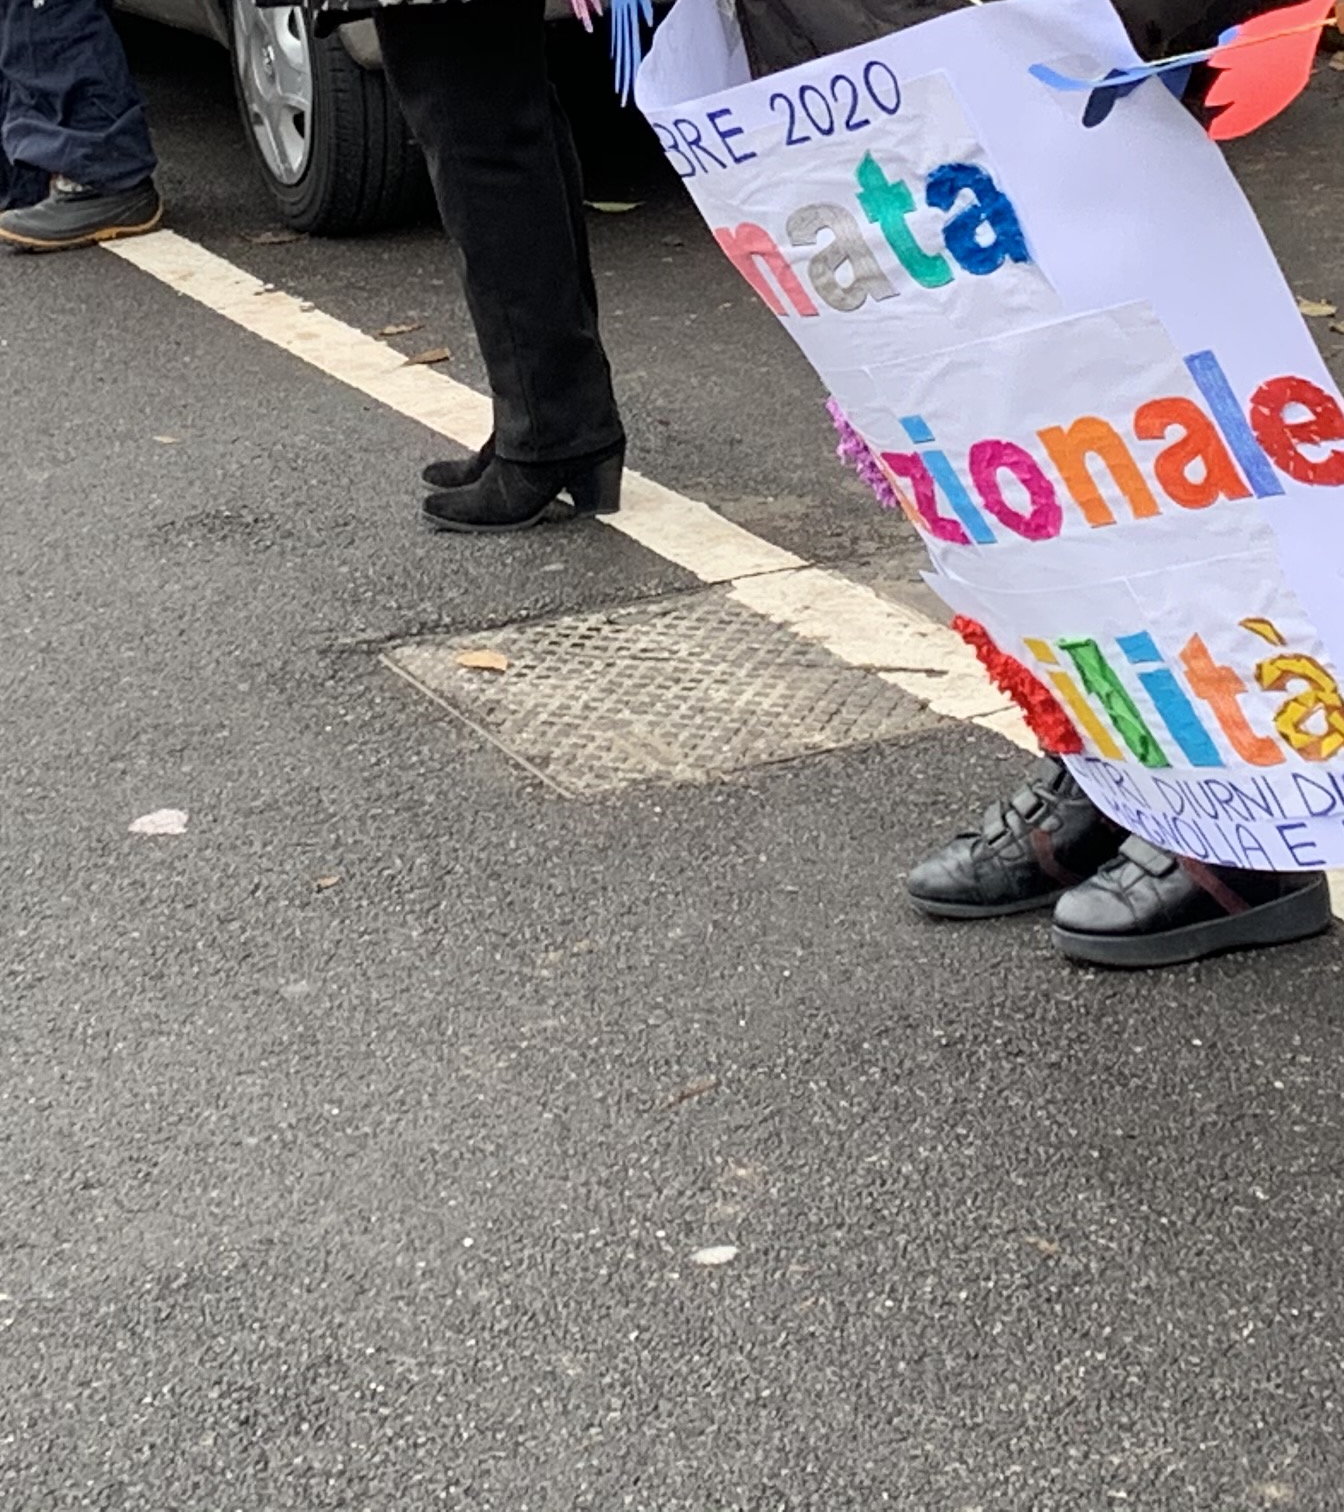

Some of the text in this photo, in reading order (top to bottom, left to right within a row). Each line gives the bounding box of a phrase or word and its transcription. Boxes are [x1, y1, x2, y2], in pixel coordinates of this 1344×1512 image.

[769, 60, 901, 147] 2020
[714, 148, 1033, 318] nata
[1074, 752, 1152, 811] TRI
[1152, 772, 1286, 823] DIURNI
[1276, 821, 1328, 868] E
